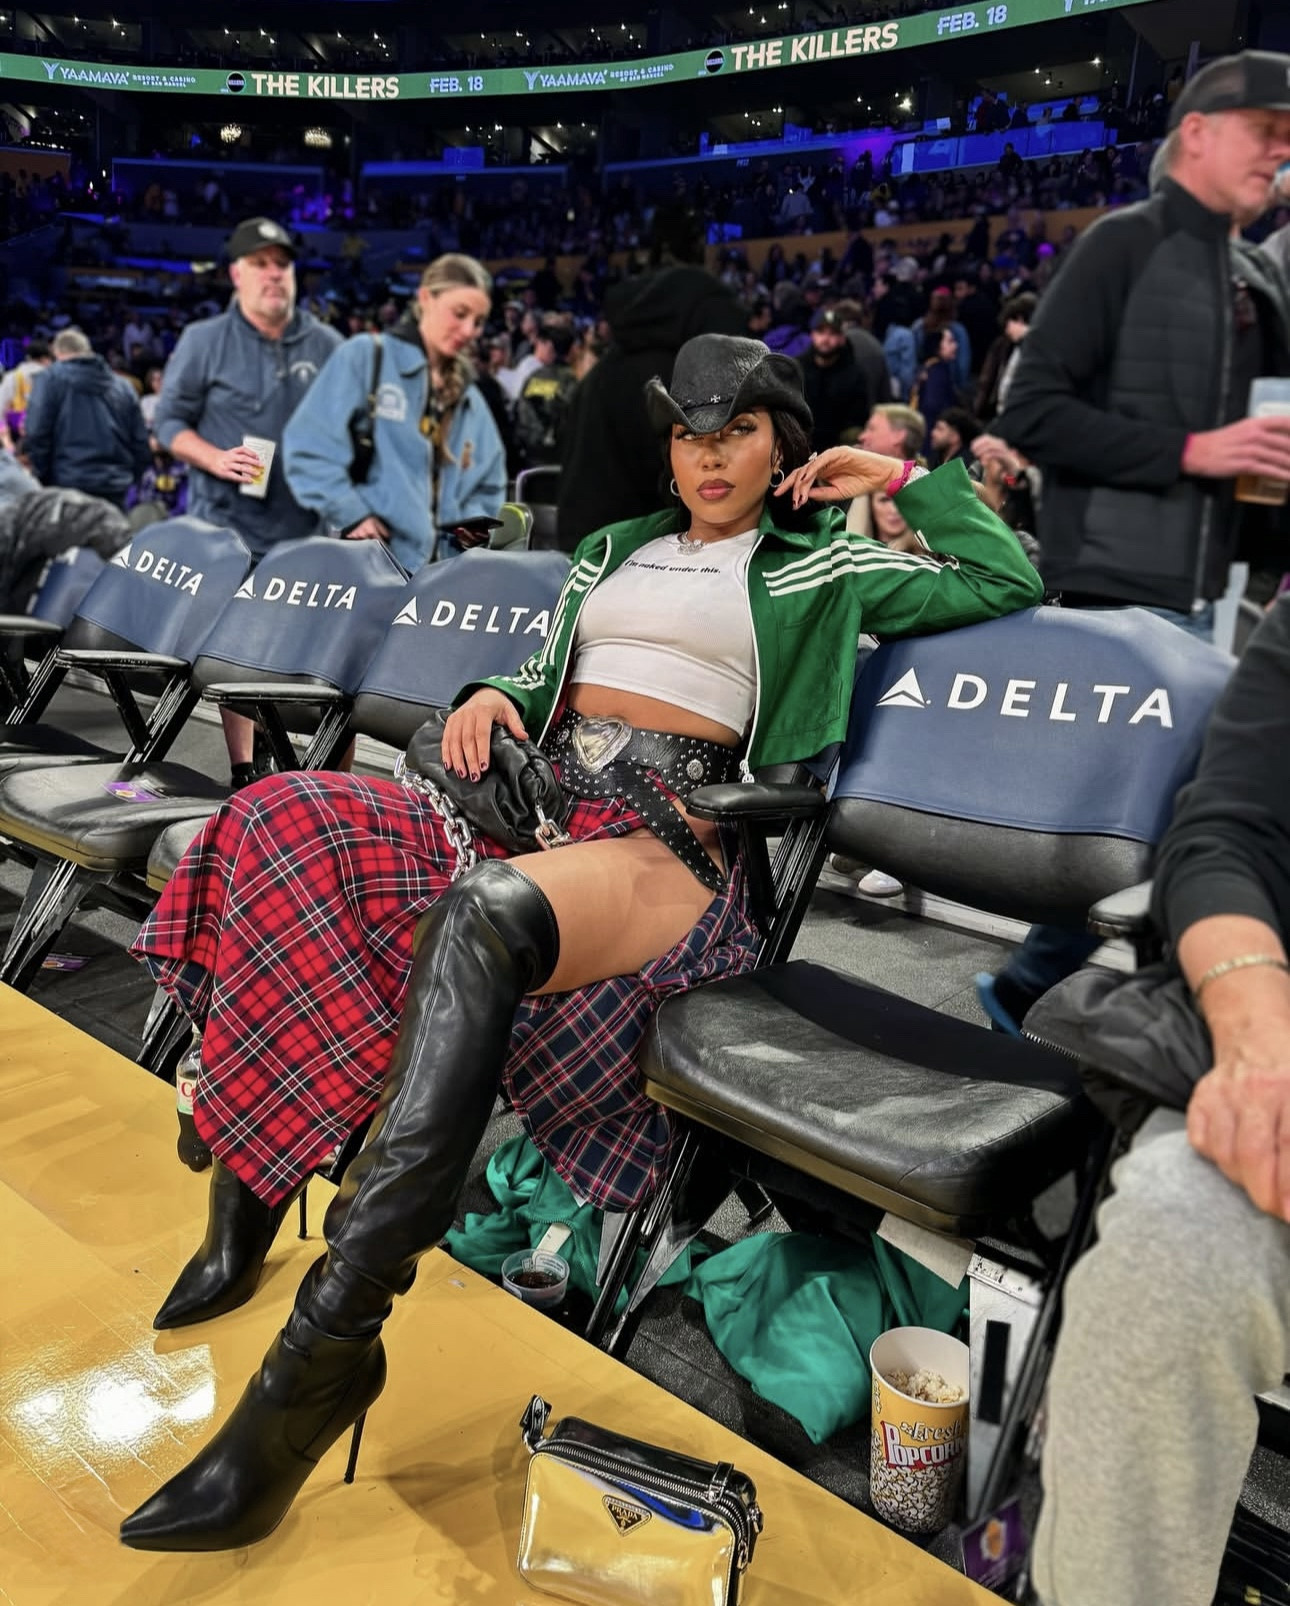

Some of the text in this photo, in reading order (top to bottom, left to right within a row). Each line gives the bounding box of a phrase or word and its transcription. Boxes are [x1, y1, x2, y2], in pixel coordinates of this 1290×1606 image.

[937, 5, 1008, 35] FEB. 18
[731, 23, 899, 70] THE KILLERS
[251, 73, 399, 99] THE KILLERS
[430, 76, 483, 93] FEB. 18
[135, 550, 203, 596] DELTA
[639, 562, 668, 571] naked
[669, 565, 698, 573] under
[263, 577, 357, 610] DELTA
[430, 600, 550, 638] DELTA
[947, 673, 1173, 728] DELTA
[612, 1504, 638, 1520] PRADA
